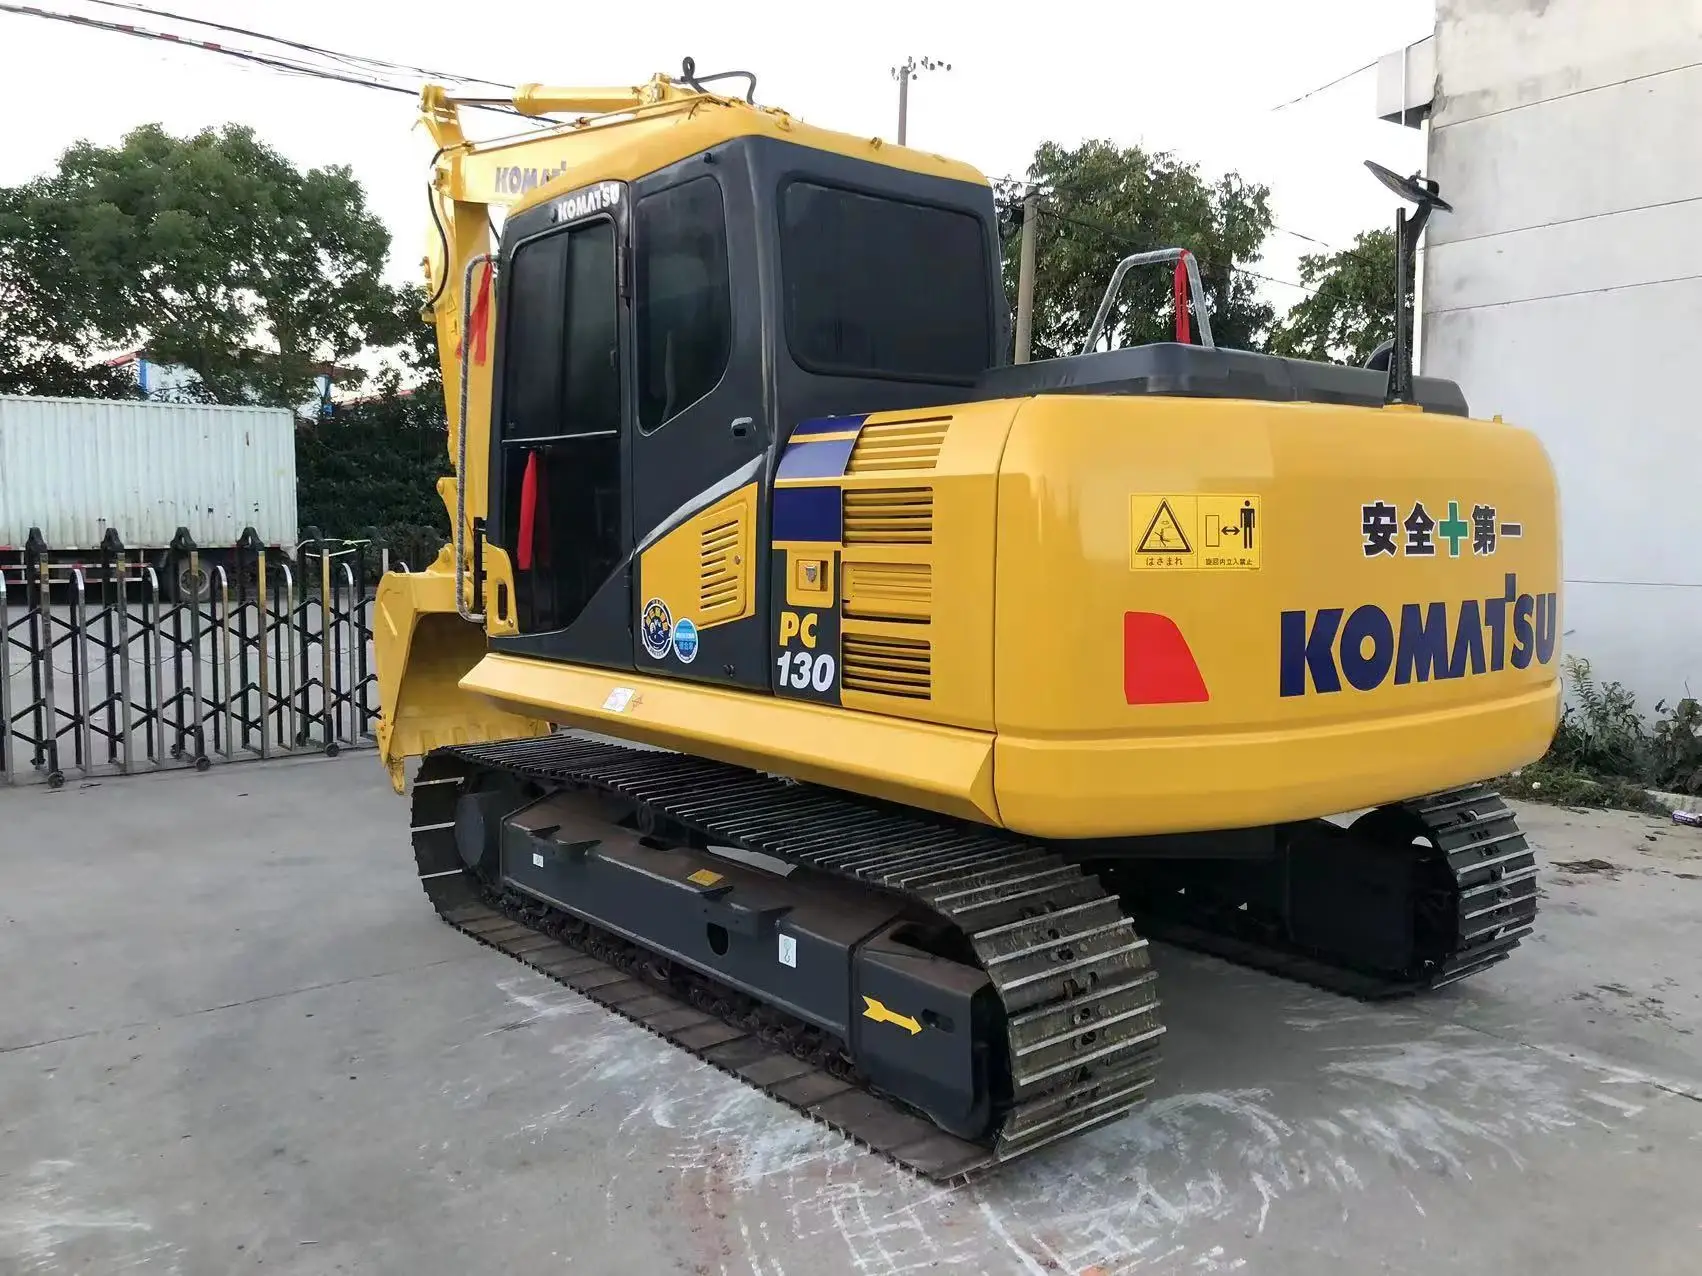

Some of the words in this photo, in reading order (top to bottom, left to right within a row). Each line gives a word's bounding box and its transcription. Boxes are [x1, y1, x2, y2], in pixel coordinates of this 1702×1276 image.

[557, 183, 620, 222] KOMATSU
[1145, 556, 1184, 567] はさまれ
[779, 611, 818, 648] PC
[1280, 573, 1557, 697] KOMATSU
[777, 651, 835, 692] 130
